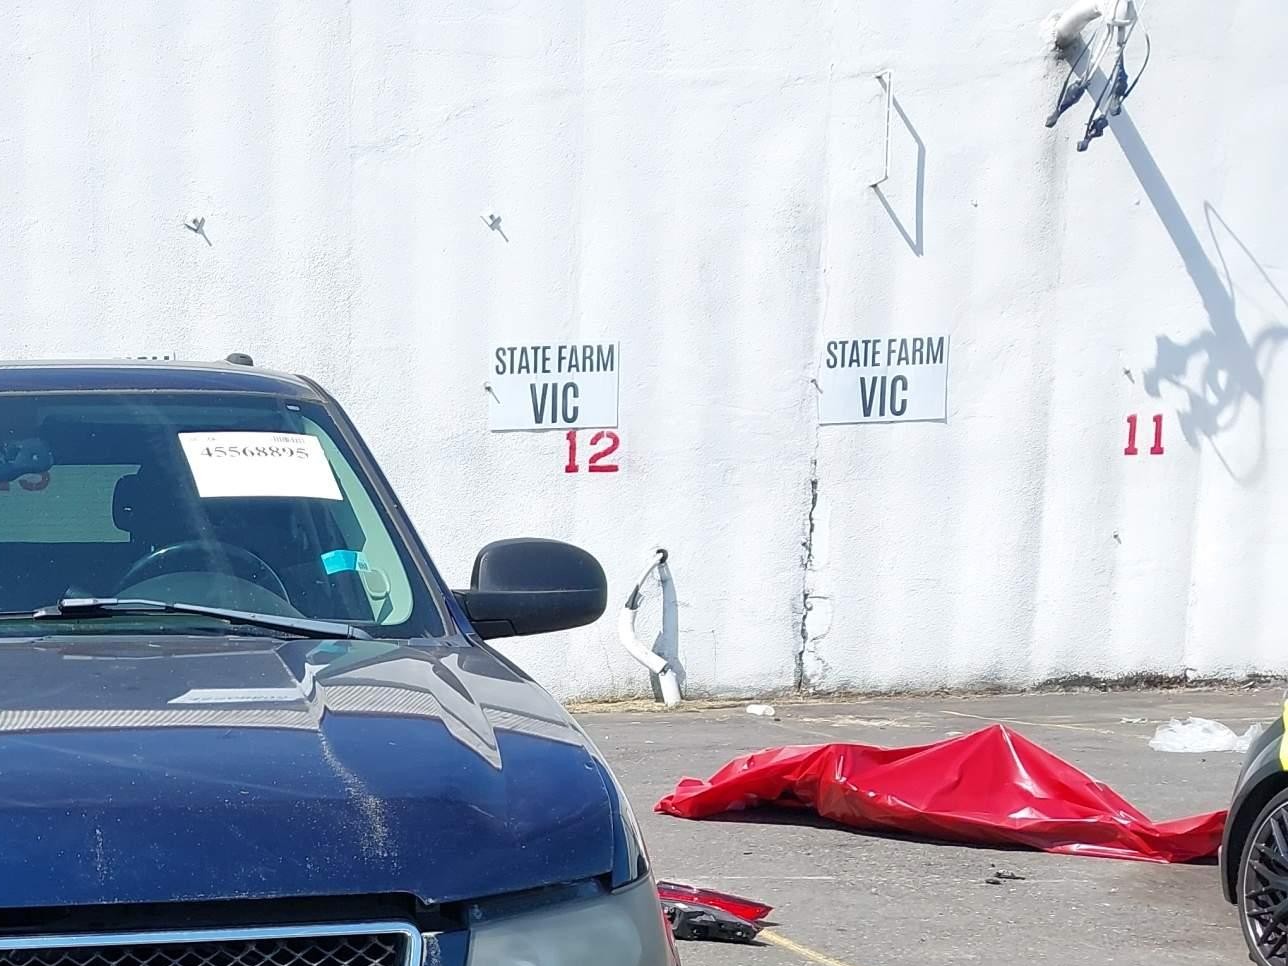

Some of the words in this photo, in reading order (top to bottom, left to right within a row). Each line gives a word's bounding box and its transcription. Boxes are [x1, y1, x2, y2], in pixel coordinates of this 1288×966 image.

[495, 345, 552, 375] STATE
[557, 344, 615, 373] FARM
[826, 339, 881, 369] STATE
[887, 336, 944, 367] FARM
[529, 381, 579, 424] VIC
[859, 374, 908, 418] VIC
[201, 446, 310, 458] 45568895
[564, 430, 620, 473] 12
[1124, 414, 1164, 455] 11
